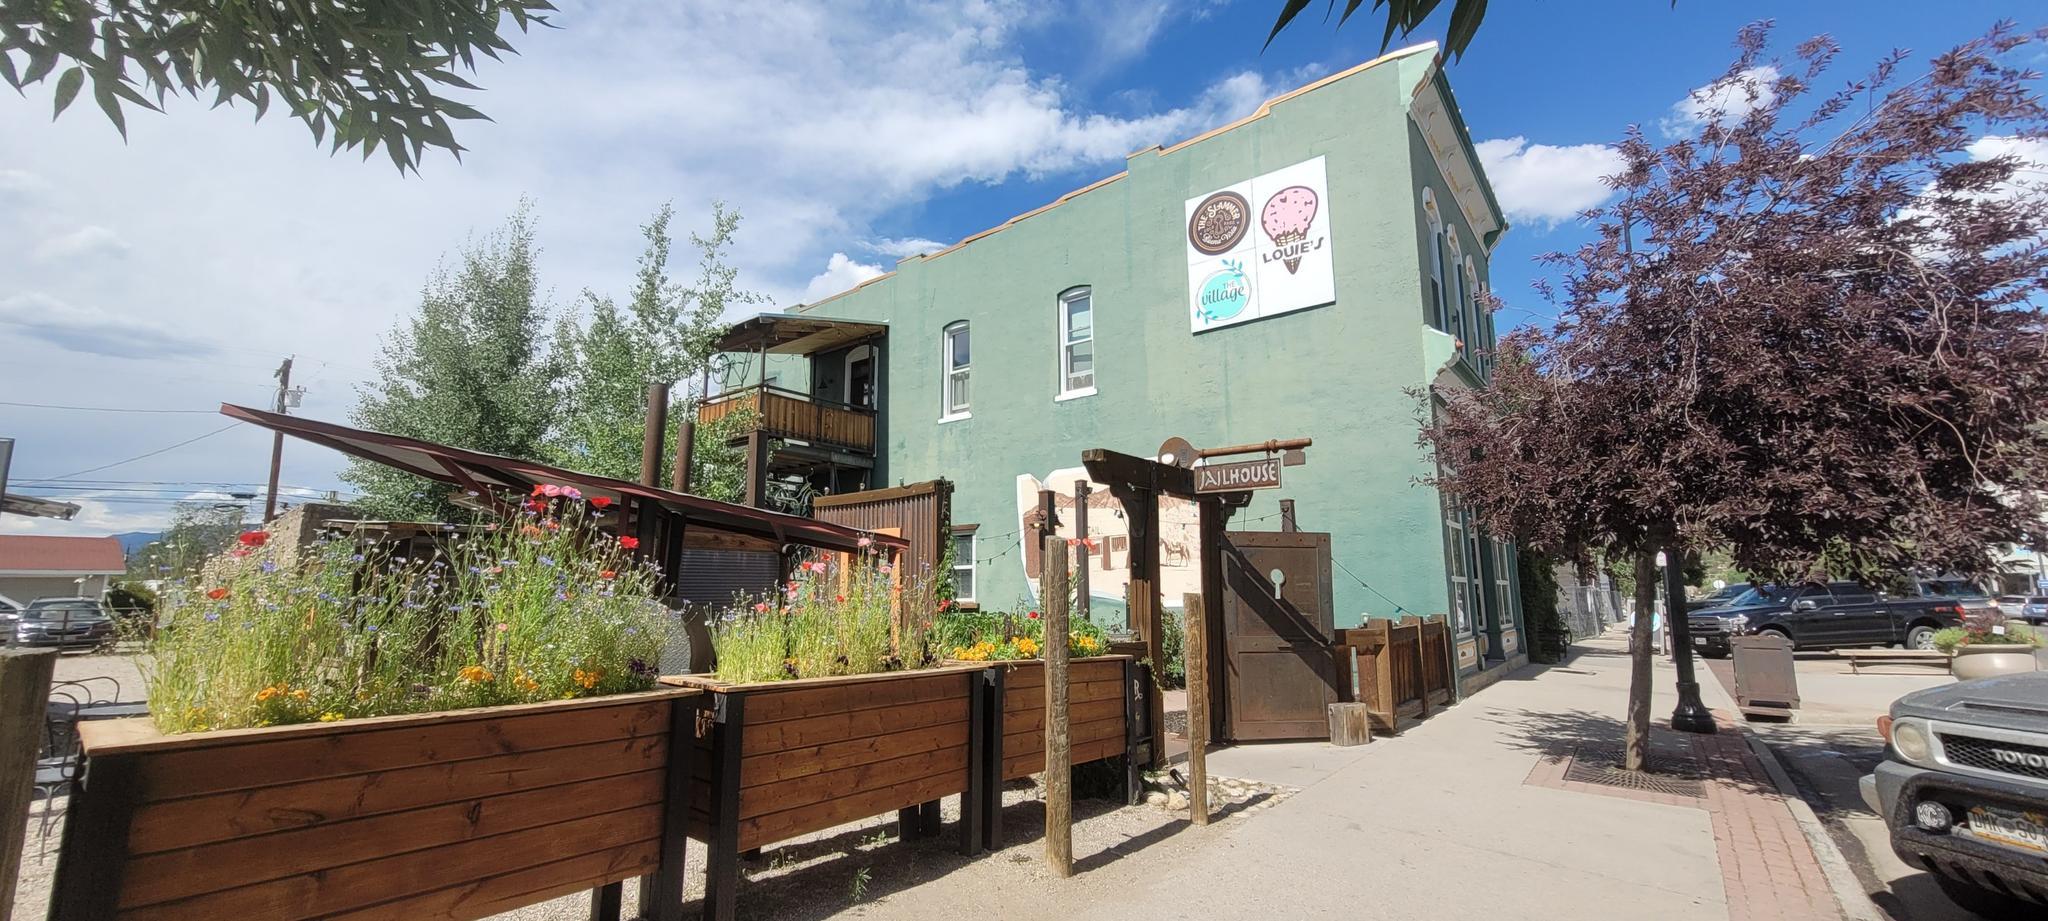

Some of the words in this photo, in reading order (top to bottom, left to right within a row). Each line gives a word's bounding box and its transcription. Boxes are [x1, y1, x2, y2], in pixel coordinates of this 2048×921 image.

[1197, 214, 1209, 232] THE
[1207, 201, 1240, 219] SLAMMER
[1262, 237, 1324, 263] LOUIE'S
[1201, 284, 1245, 307] village
[1222, 280, 1236, 290] THE
[1199, 464, 1276, 490] JAILHOUSE
